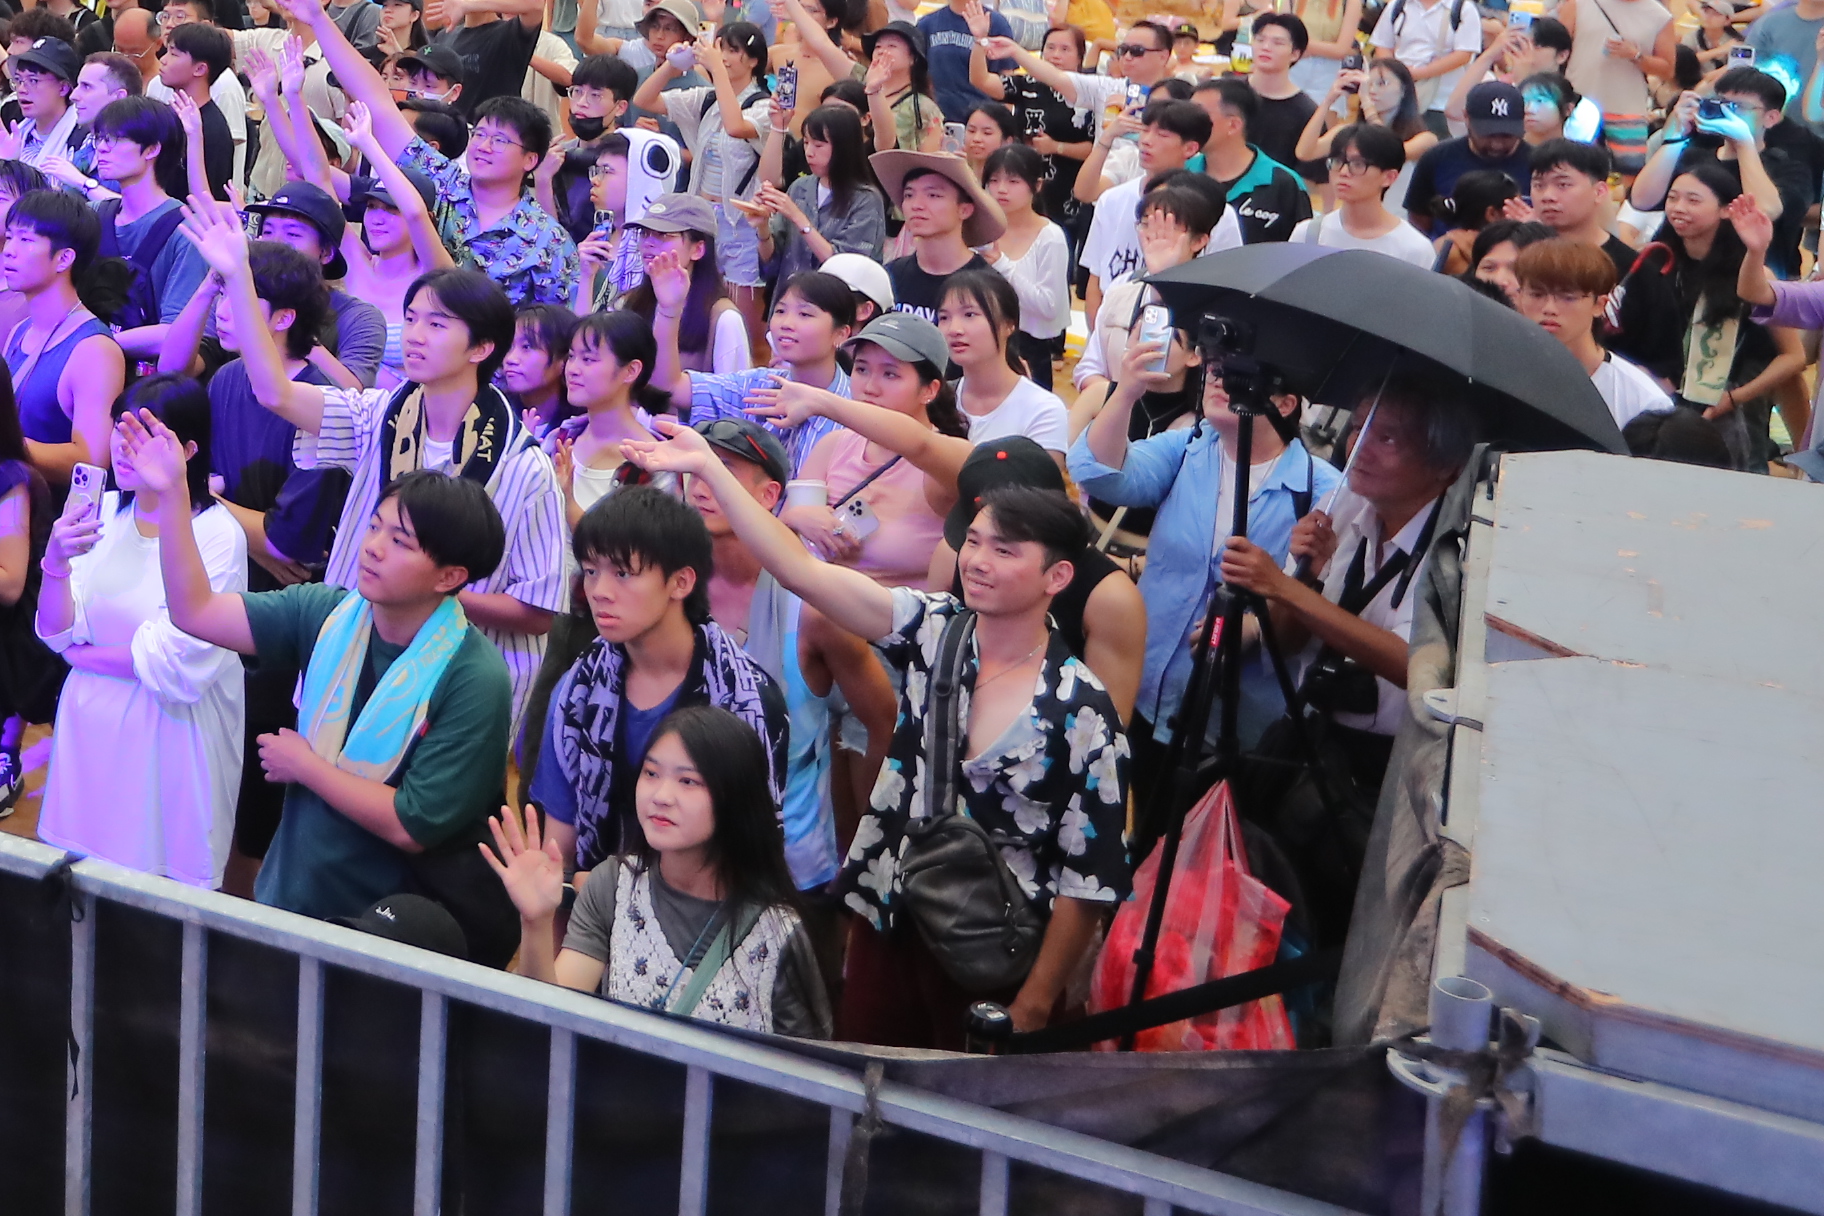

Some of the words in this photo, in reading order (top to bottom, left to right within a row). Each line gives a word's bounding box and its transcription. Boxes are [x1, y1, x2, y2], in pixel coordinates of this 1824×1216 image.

[1491, 97, 1508, 116] NY
[1238, 197, 1255, 216] le
[1254, 209, 1280, 228] coq
